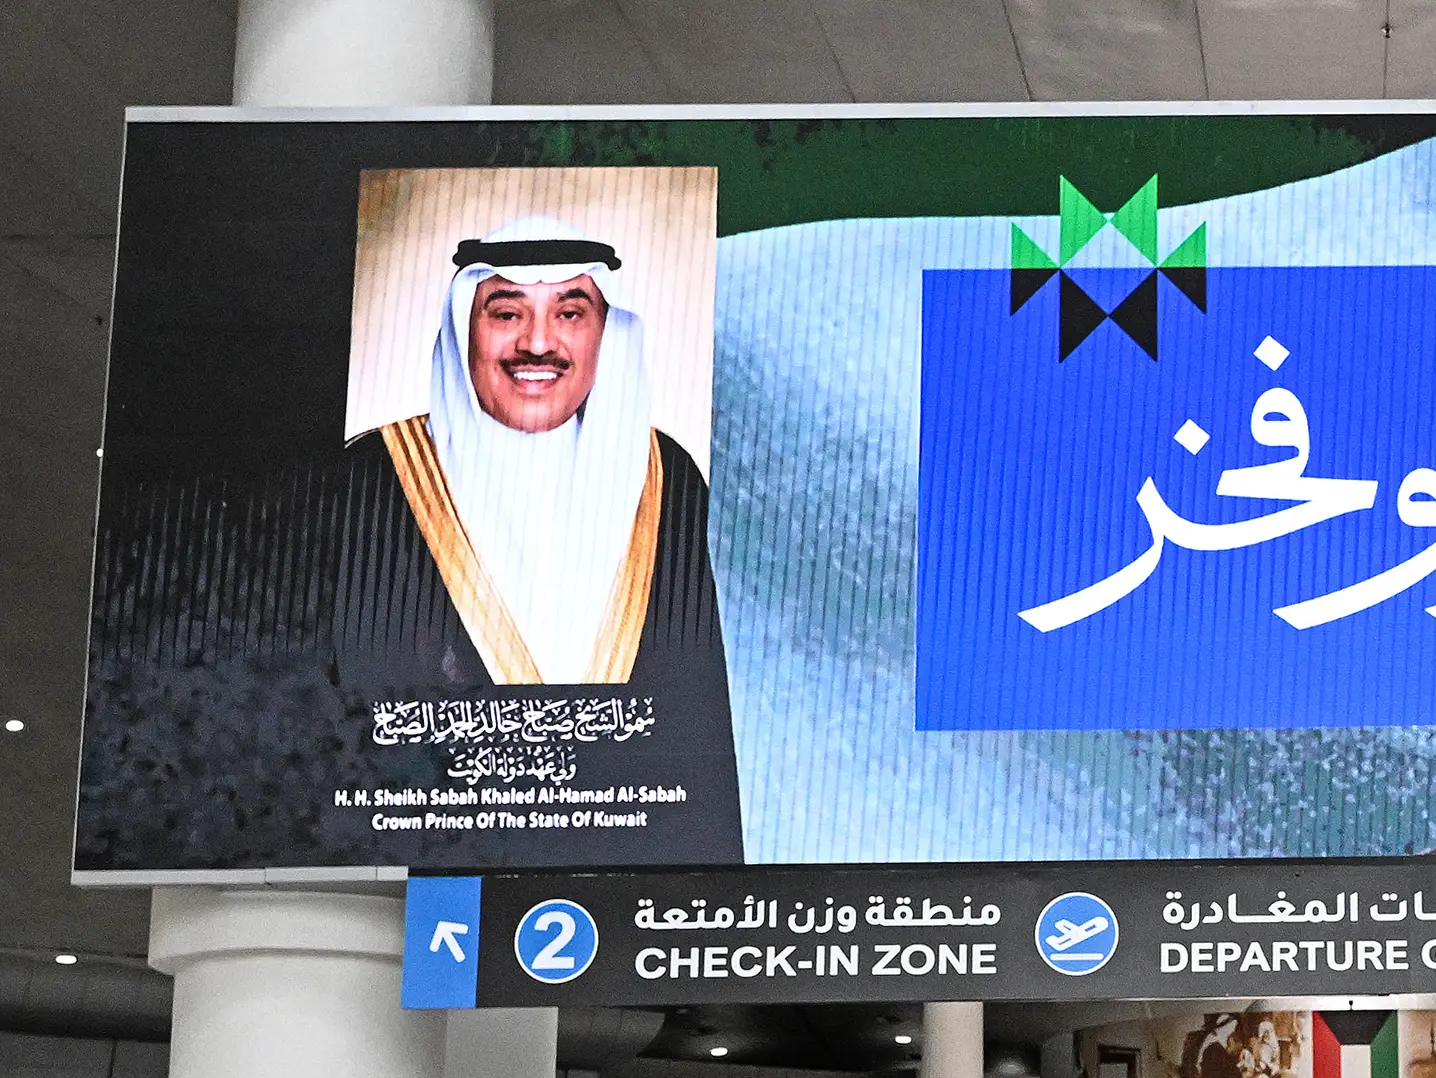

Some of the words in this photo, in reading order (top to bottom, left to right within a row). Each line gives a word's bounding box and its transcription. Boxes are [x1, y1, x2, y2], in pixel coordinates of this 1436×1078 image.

[335, 789, 352, 807] H.
[354, 789, 372, 807] H.
[374, 788, 427, 806] Sheikh
[430, 787, 478, 806] Sabah
[481, 786, 535, 805] Khaled
[538, 786, 615, 804] Al-Hamad
[617, 785, 687, 803] Al-Sabah
[372, 813, 422, 830] Crown
[425, 813, 473, 830] Prince
[476, 812, 496, 829] Of
[497, 811, 526, 829] The
[529, 811, 569, 828] State
[571, 810, 592, 828] Of
[594, 810, 648, 828] Kuwait
[634, 896, 778, 931] الأمتعة
[788, 902, 857, 933] وزن
[865, 896, 1001, 930] منطقة
[1162, 890, 1360, 932] المغادرة
[531, 911, 576, 970] 2
[1159, 938, 1411, 974] DEPARTURE
[635, 945, 860, 979] CHECK-IN
[871, 943, 998, 976] ZONE
